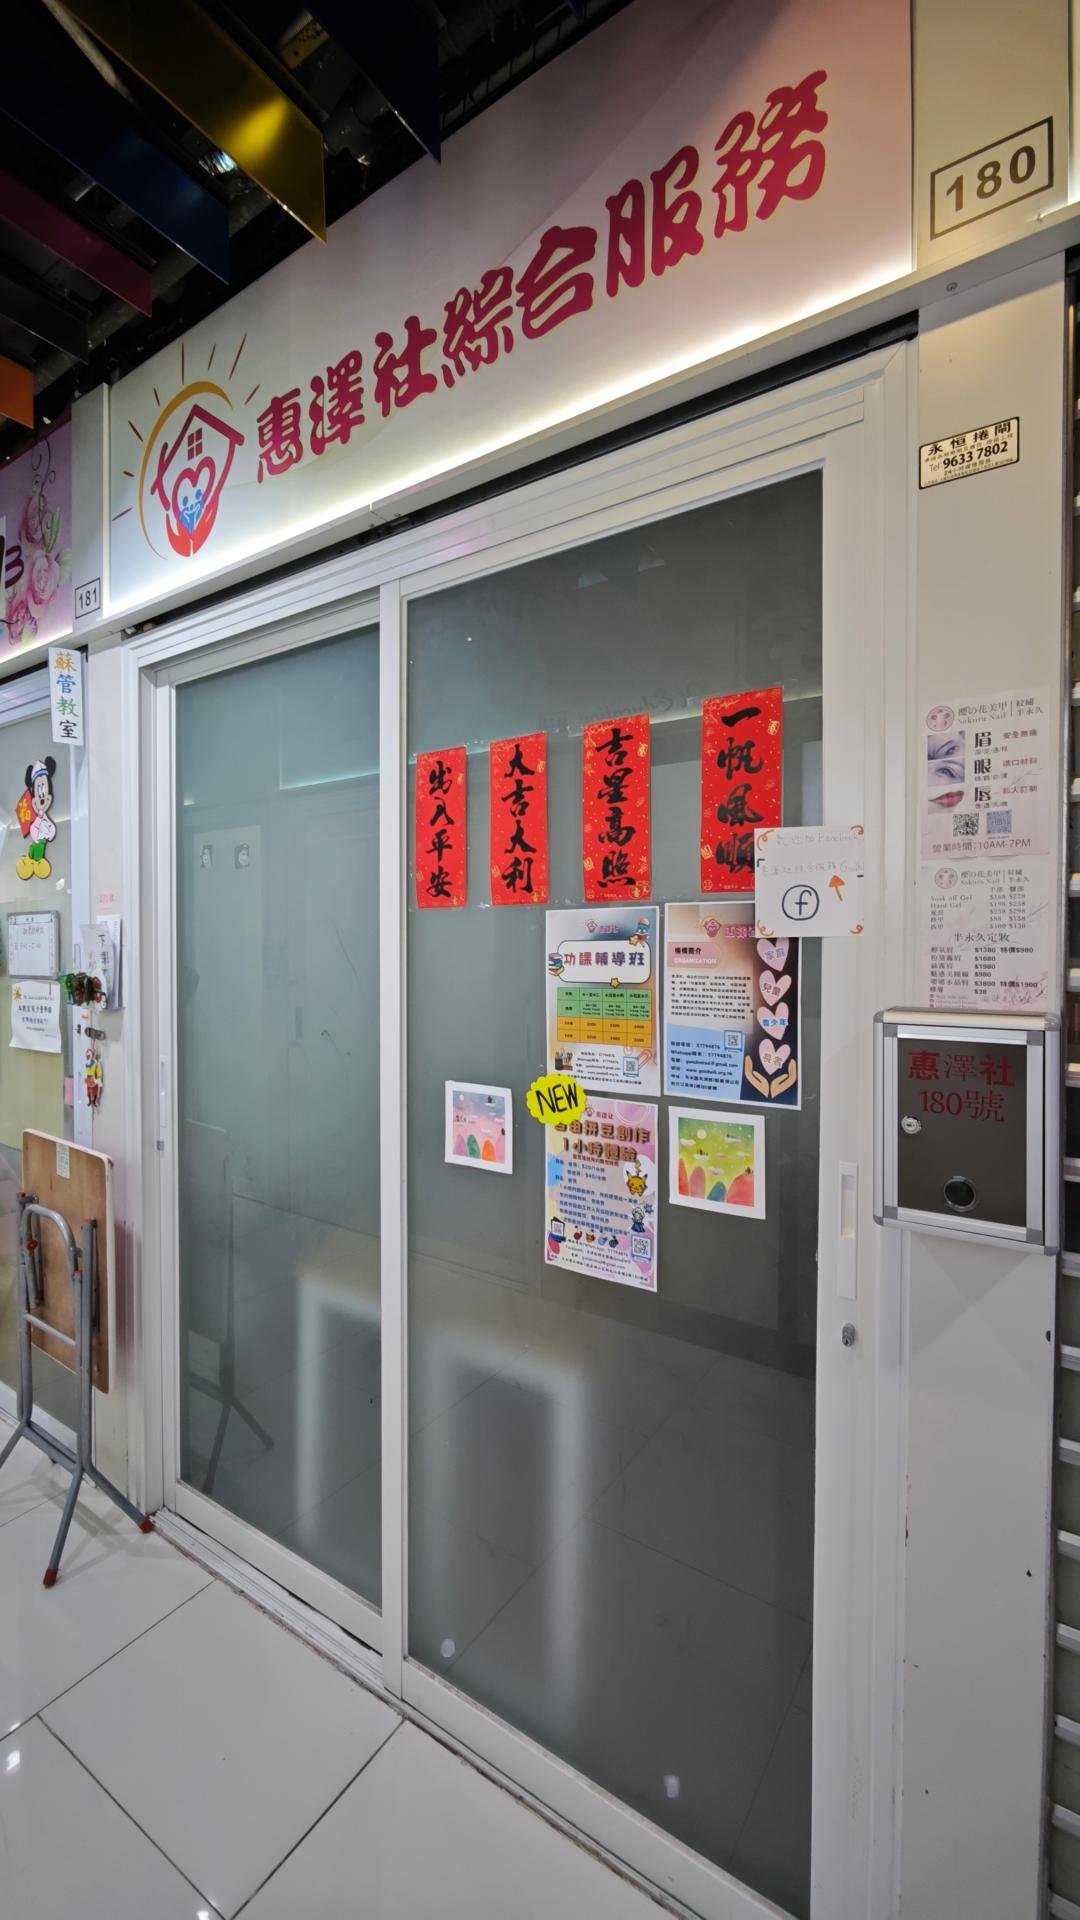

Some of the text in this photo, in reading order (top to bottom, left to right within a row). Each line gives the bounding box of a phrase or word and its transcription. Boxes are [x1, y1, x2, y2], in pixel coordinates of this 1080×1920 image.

[945, 144, 1037, 214] 180
[256, 69, 829, 484] 惠澤社綜合服務
[943, 451, 973, 470] 9633
[976, 441, 1008, 459] 7802
[78, 588, 98, 610] 181
[54, 651, 79, 740] 蘇管教室
[975, 731, 992, 749] 眉
[974, 758, 992, 775] 眼
[501, 744, 537, 894] 大吉大利
[595, 728, 637, 889] 吉星高照
[426, 760, 456, 898] 出入平安
[563, 951, 645, 967] 功課輔導班
[907, 1050, 1016, 1088] 惠澤社
[536, 1082, 580, 1117] NEW
[920, 1089, 1005, 1122] 180號
